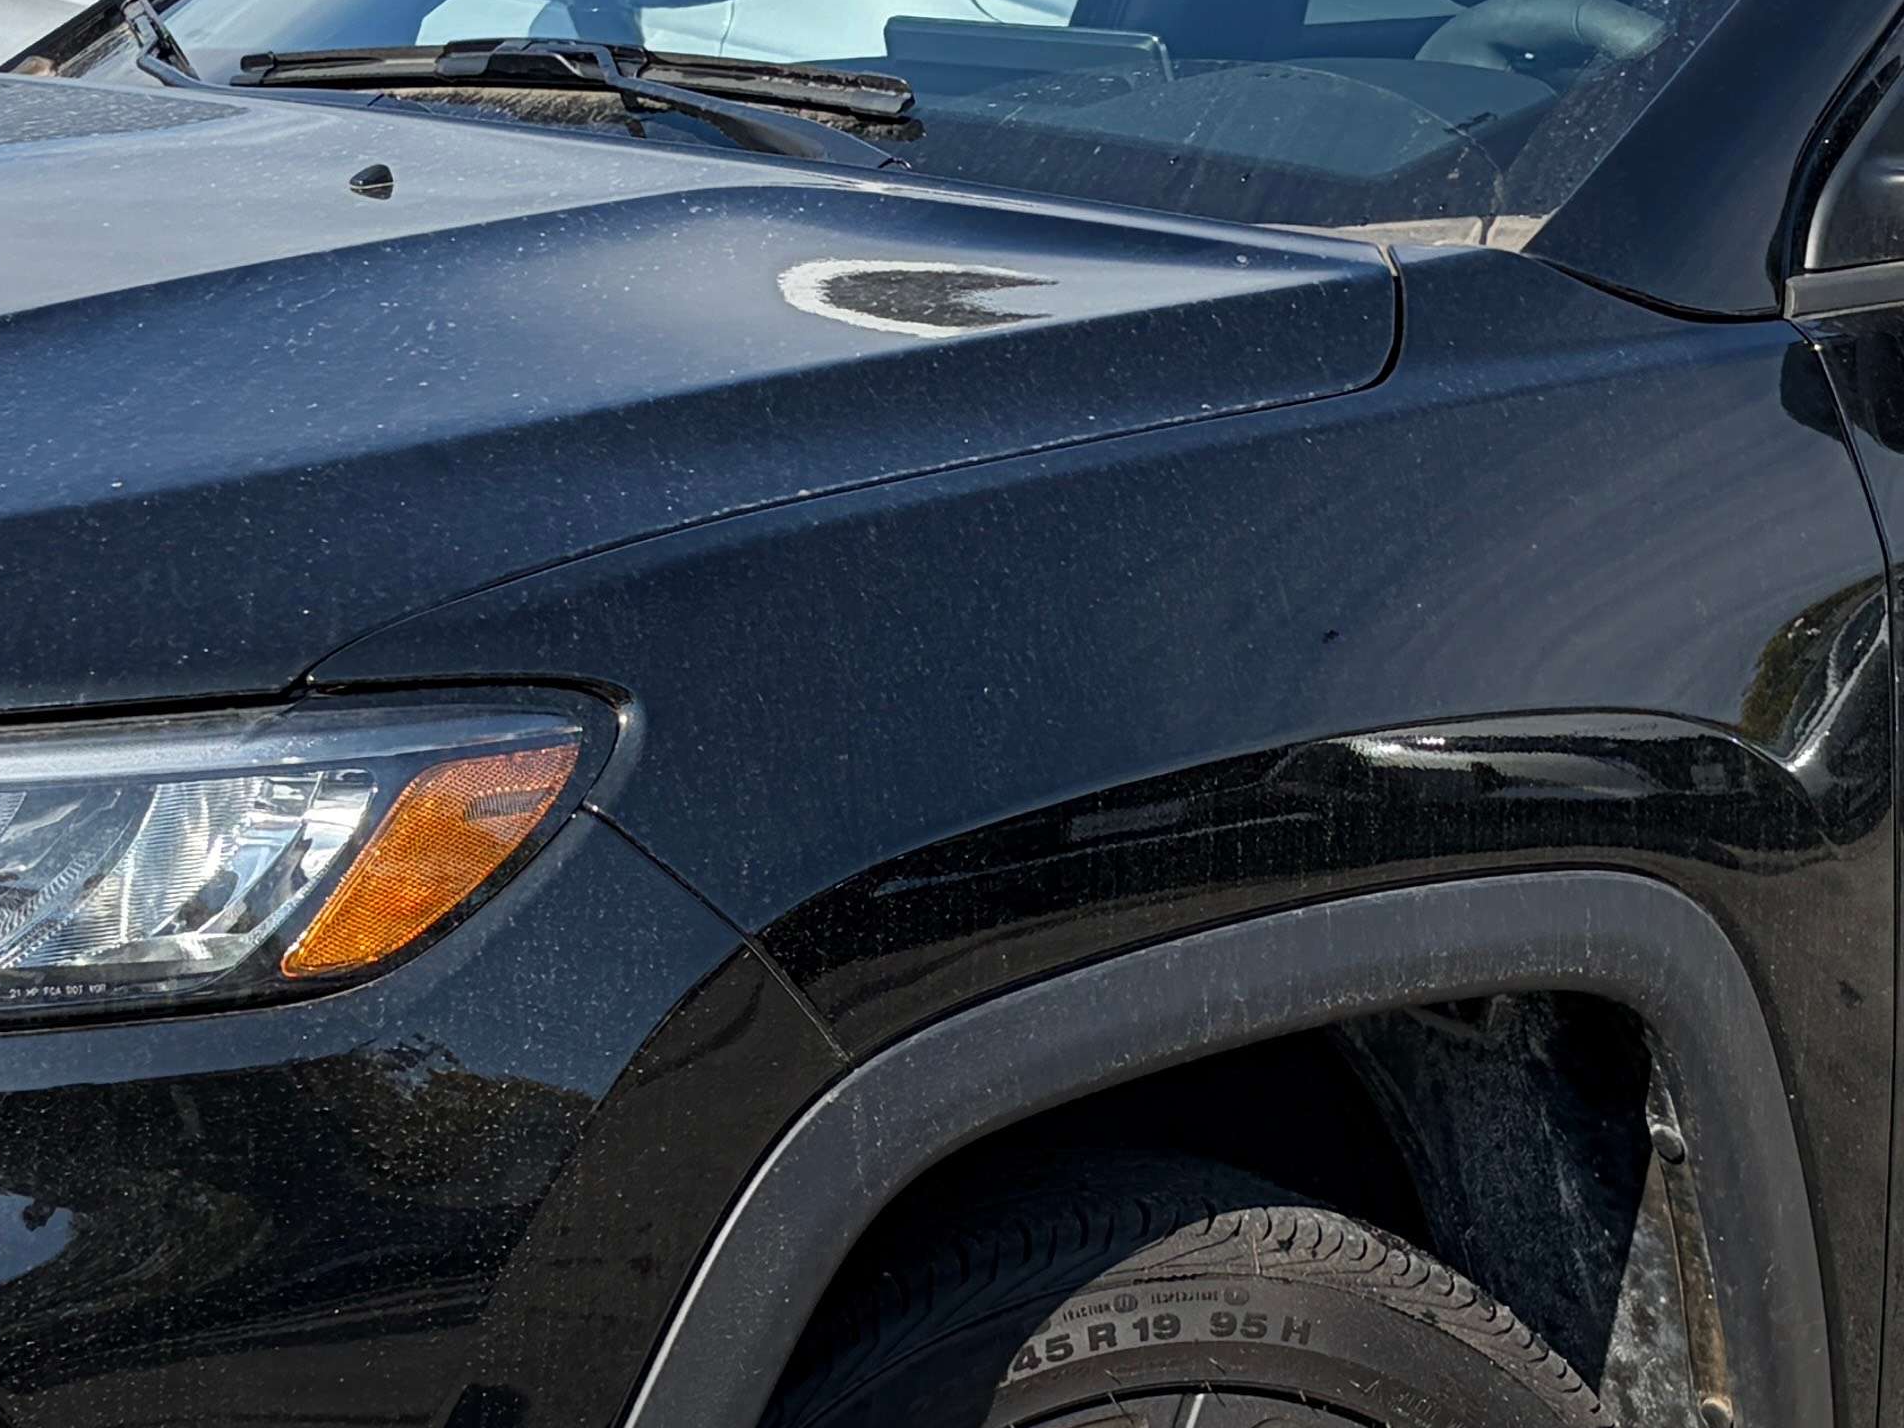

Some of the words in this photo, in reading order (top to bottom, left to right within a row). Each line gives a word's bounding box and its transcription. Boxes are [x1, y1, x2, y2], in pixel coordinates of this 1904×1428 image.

[1087, 1321, 1118, 1352] R
[1131, 1312, 1182, 1343] 19
[1208, 1311, 1268, 1340] 95
[1280, 1315, 1312, 1346] H
